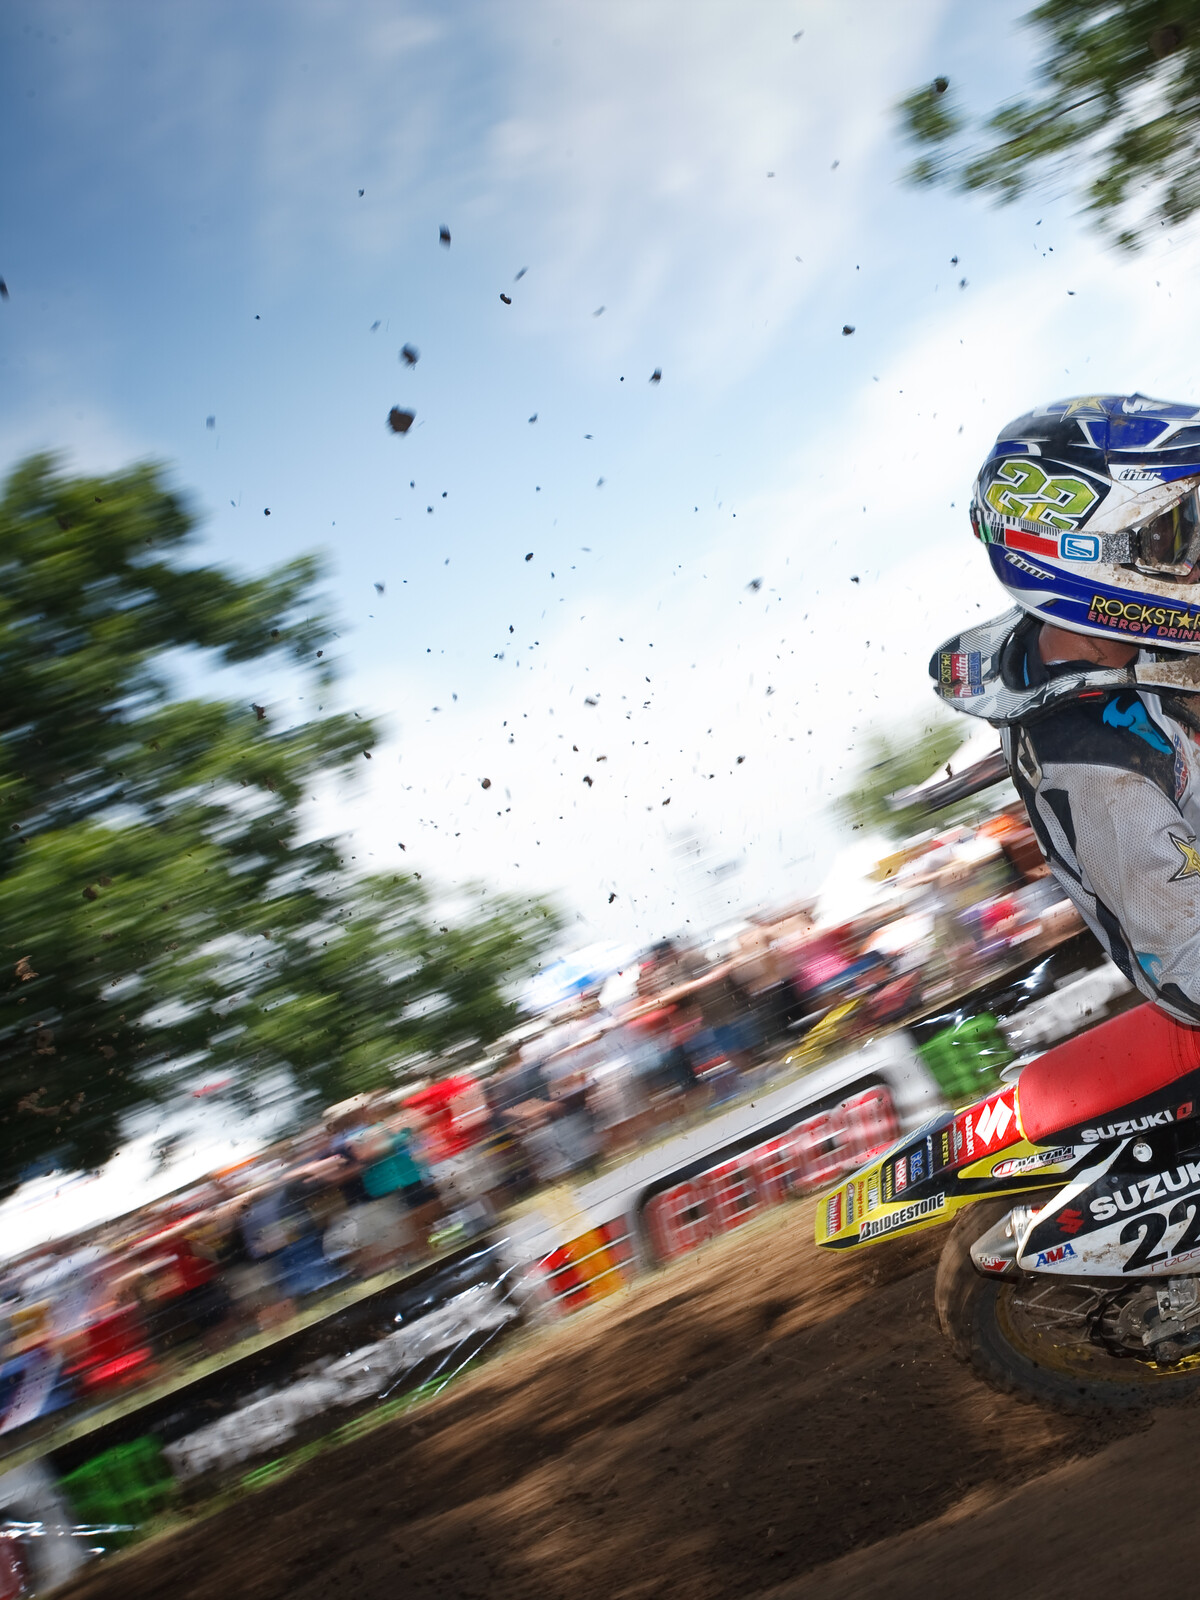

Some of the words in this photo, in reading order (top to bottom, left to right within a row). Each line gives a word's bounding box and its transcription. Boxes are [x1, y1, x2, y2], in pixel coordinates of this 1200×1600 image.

[1118, 468, 1162, 481] thor
[985, 459, 1100, 531] 22
[1004, 552, 1056, 581] thor
[1088, 610, 1152, 634] ENERGY
[964, 1113, 975, 1156] SUZUKI
[1081, 1109, 1174, 1143] SUZUKI
[941, 1131, 949, 1166] EXCEL
[860, 1192, 944, 1242] BRIDGESTONE
[1035, 1243, 1075, 1268] AMA
